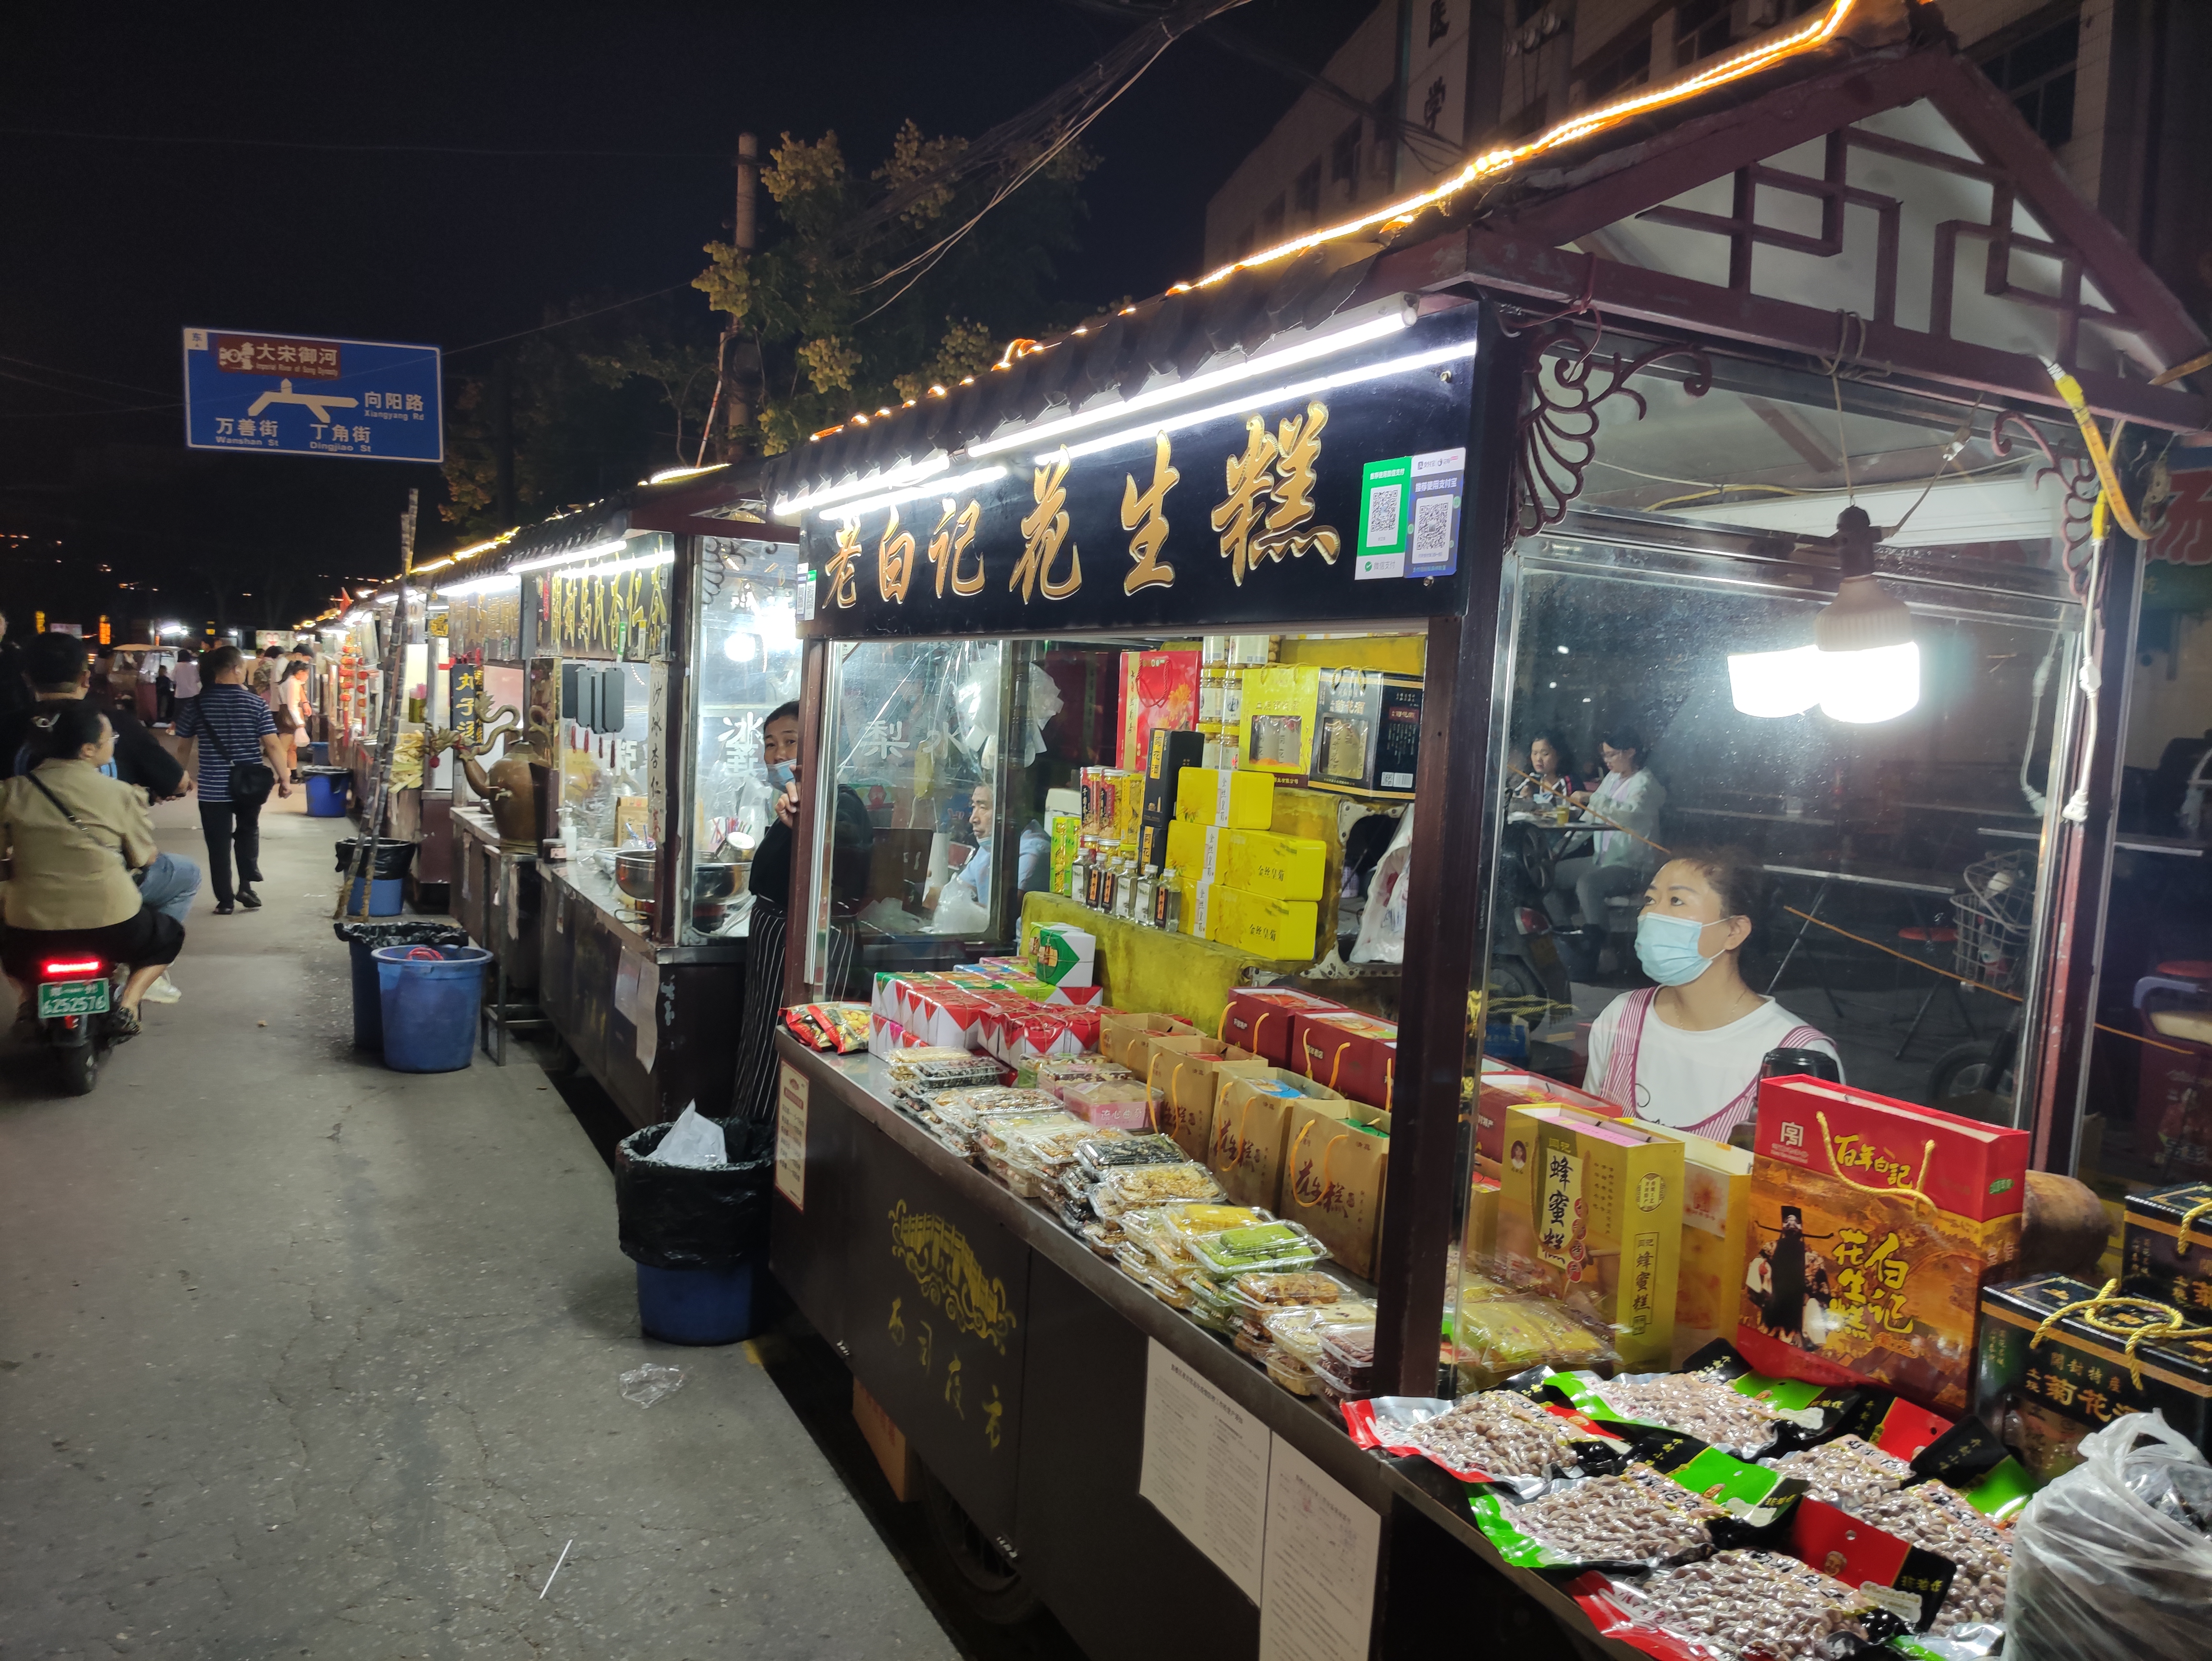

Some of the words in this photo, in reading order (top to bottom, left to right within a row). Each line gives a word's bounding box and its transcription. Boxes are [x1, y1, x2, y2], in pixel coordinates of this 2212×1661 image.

[256, 343, 338, 366] 大宋御河
[365, 391, 424, 411] 向阳路
[364, 410, 409, 421] Xiangyang
[413, 412, 424, 421] Rd
[215, 417, 278, 437] 万善街
[310, 424, 371, 443] 丁角街
[310, 441, 354, 452] Dingjiao
[1415, 477, 1458, 493] 推荐使用支付宝
[1373, 561, 1396, 570] 微信支付
[1101, 1107, 1143, 1121] 流心曲奇
[1632, 1251, 1654, 1312] 蜂蜜糕
